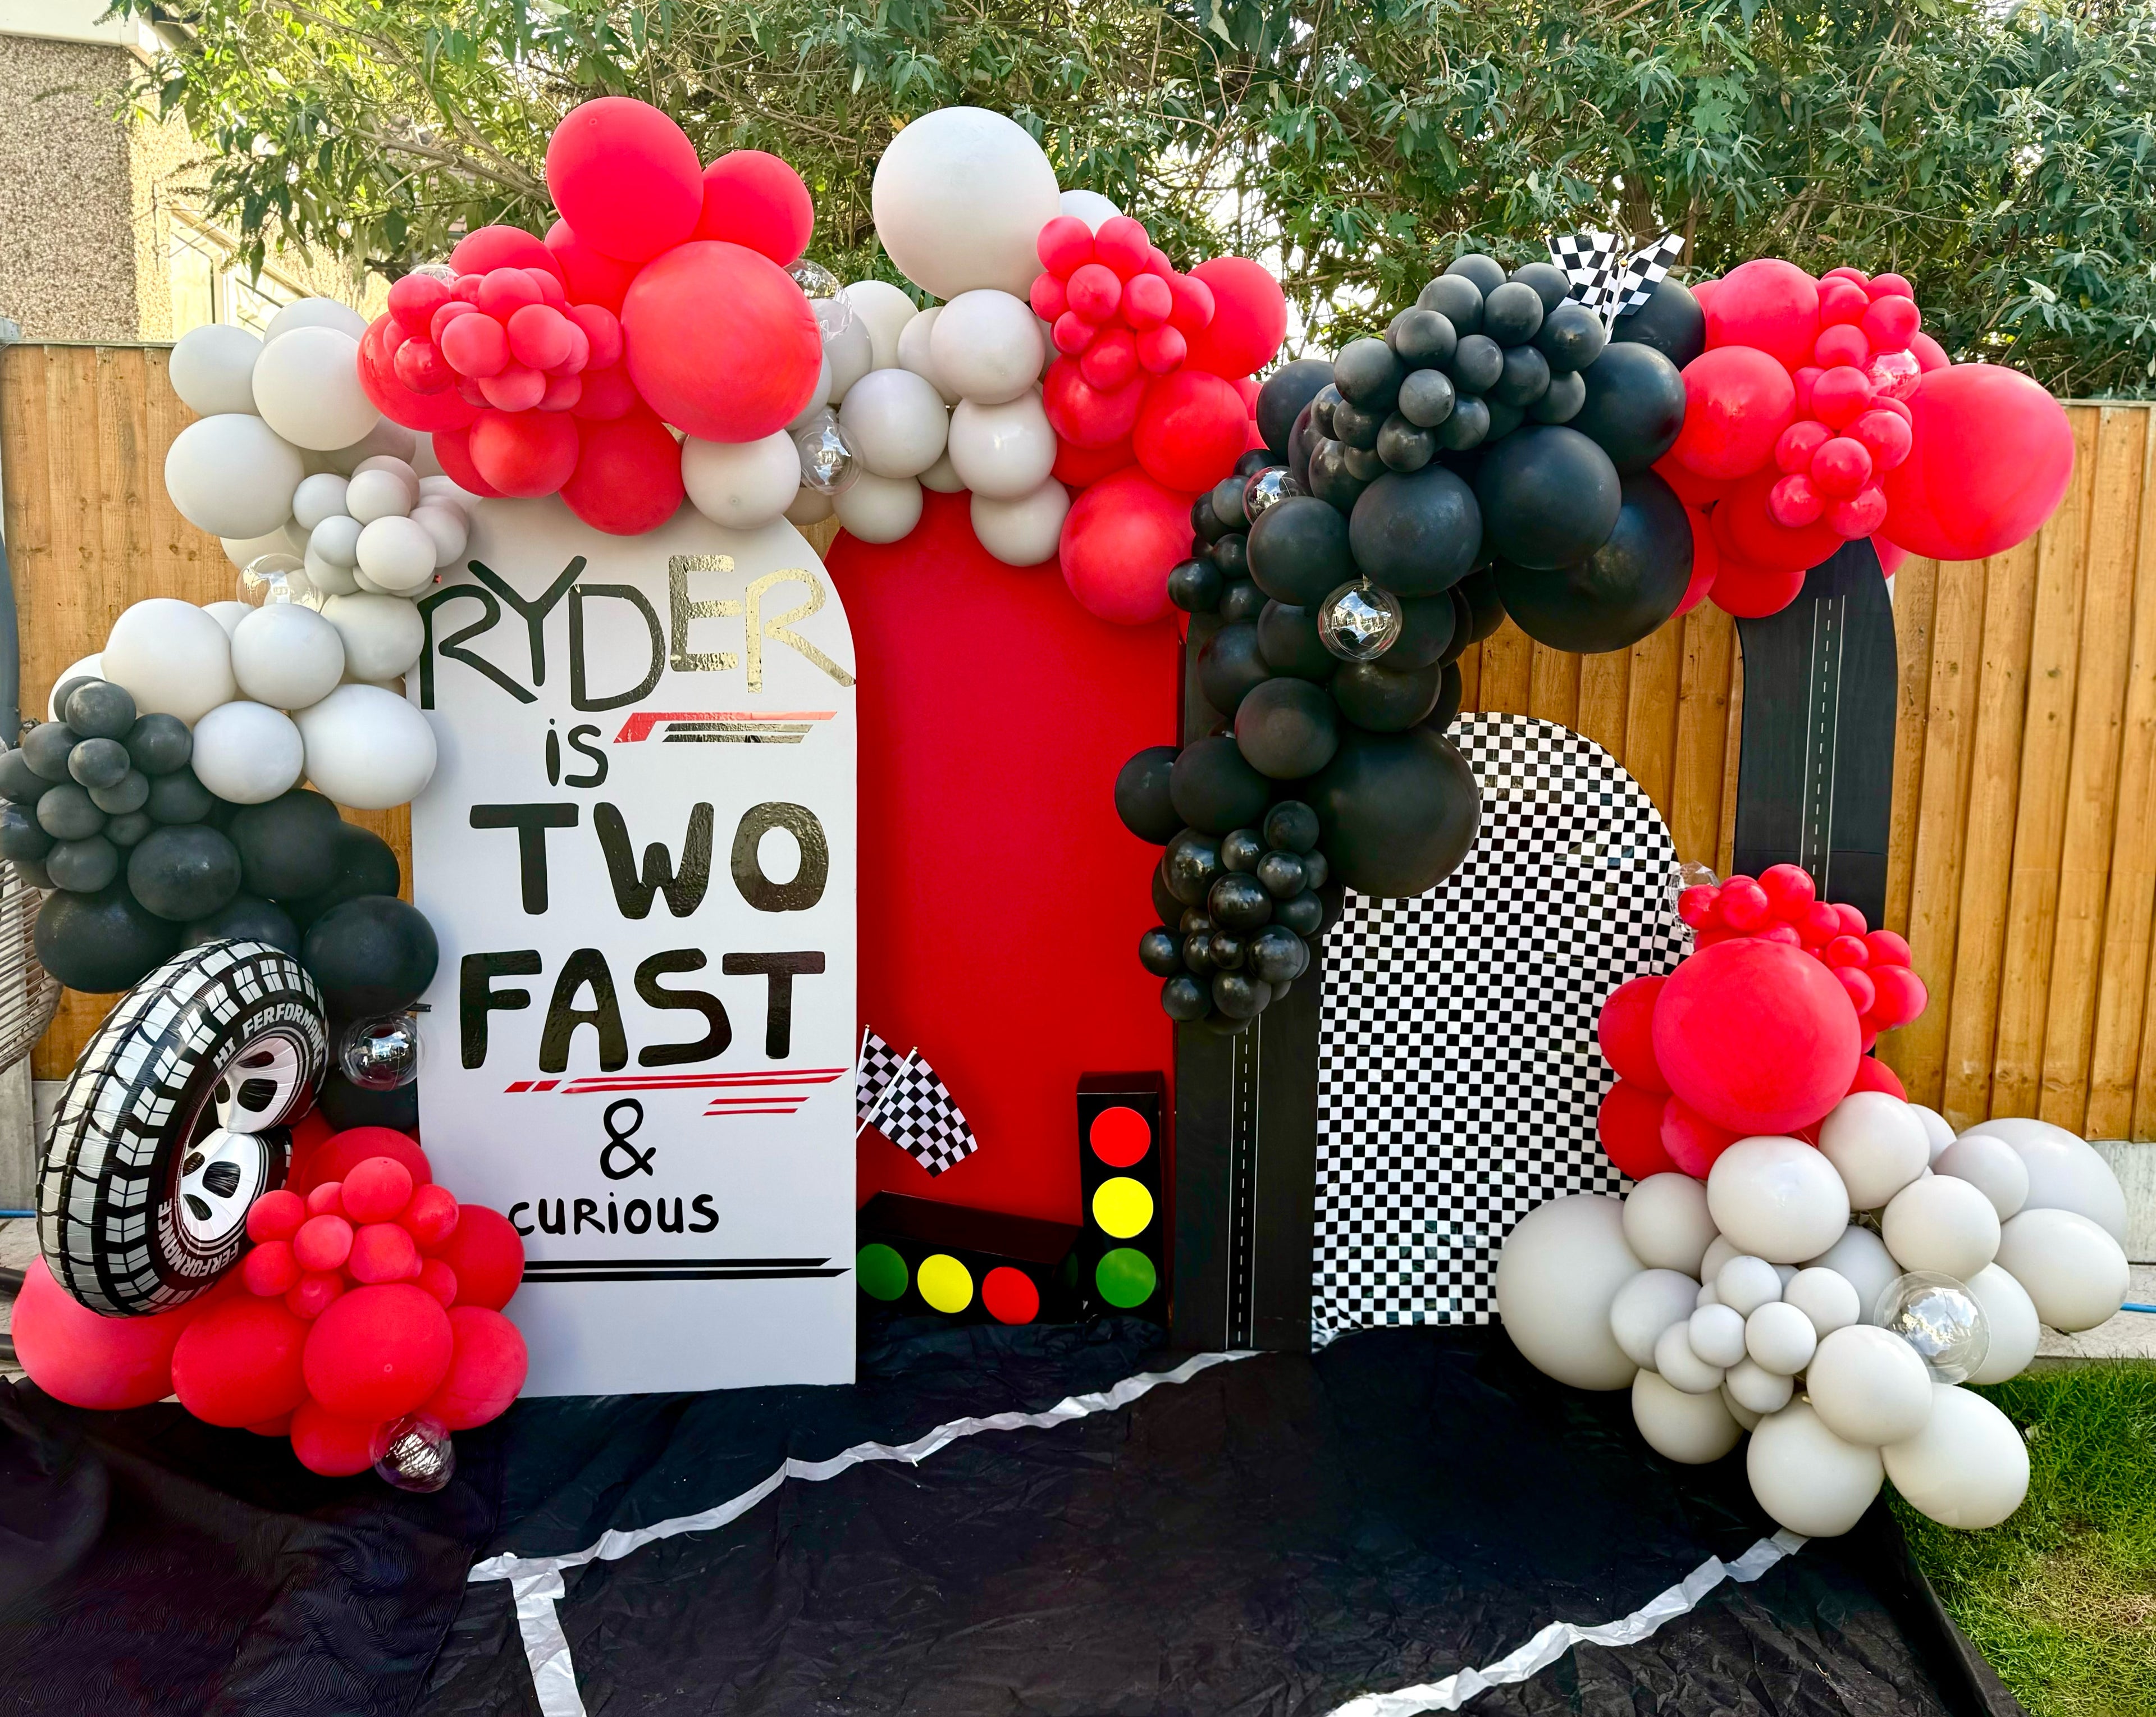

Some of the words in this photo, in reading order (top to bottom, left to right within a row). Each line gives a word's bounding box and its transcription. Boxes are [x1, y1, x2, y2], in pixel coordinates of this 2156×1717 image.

[417, 555, 856, 711] RYDER
[469, 802, 829, 919] TWO
[213, 1036, 236, 1070] HI
[460, 948, 825, 1073] FAST
[600, 1098, 656, 1180] &
